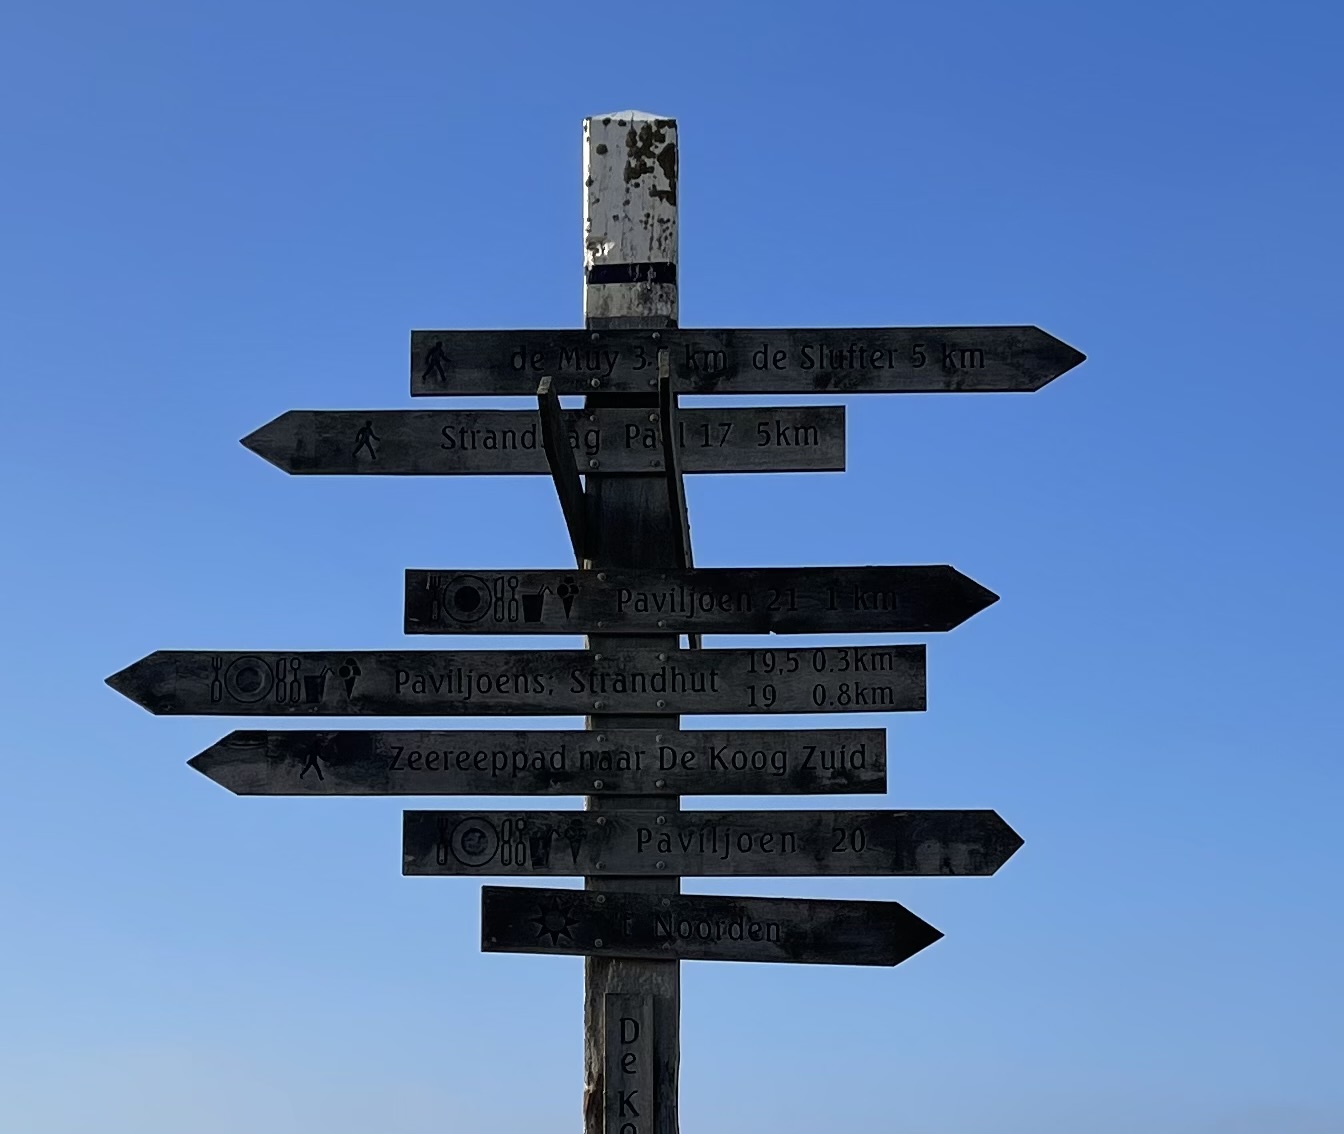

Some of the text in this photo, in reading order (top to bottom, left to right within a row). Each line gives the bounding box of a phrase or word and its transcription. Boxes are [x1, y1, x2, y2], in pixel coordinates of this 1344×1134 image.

[511, 345, 545, 371] de
[558, 346, 619, 377] Muy
[685, 344, 728, 371] km
[752, 343, 787, 371] de
[799, 343, 898, 370] Slufter
[912, 343, 926, 369] 5
[941, 342, 986, 369] km
[440, 420, 819, 456] Strandag Pal 17 5km
[616, 586, 752, 618] Paviljoen
[767, 587, 799, 612] 21
[853, 583, 898, 611] km
[812, 649, 894, 673] 0.3km
[570, 666, 720, 694] Strandhut
[746, 683, 895, 707] 19 0.8km
[389, 743, 867, 778] Zeereeppad naar De Koog Zuid
[636, 826, 867, 860] Paviljoen 20
[654, 910, 781, 943] Noorden
[619, 1017, 640, 1074] De
